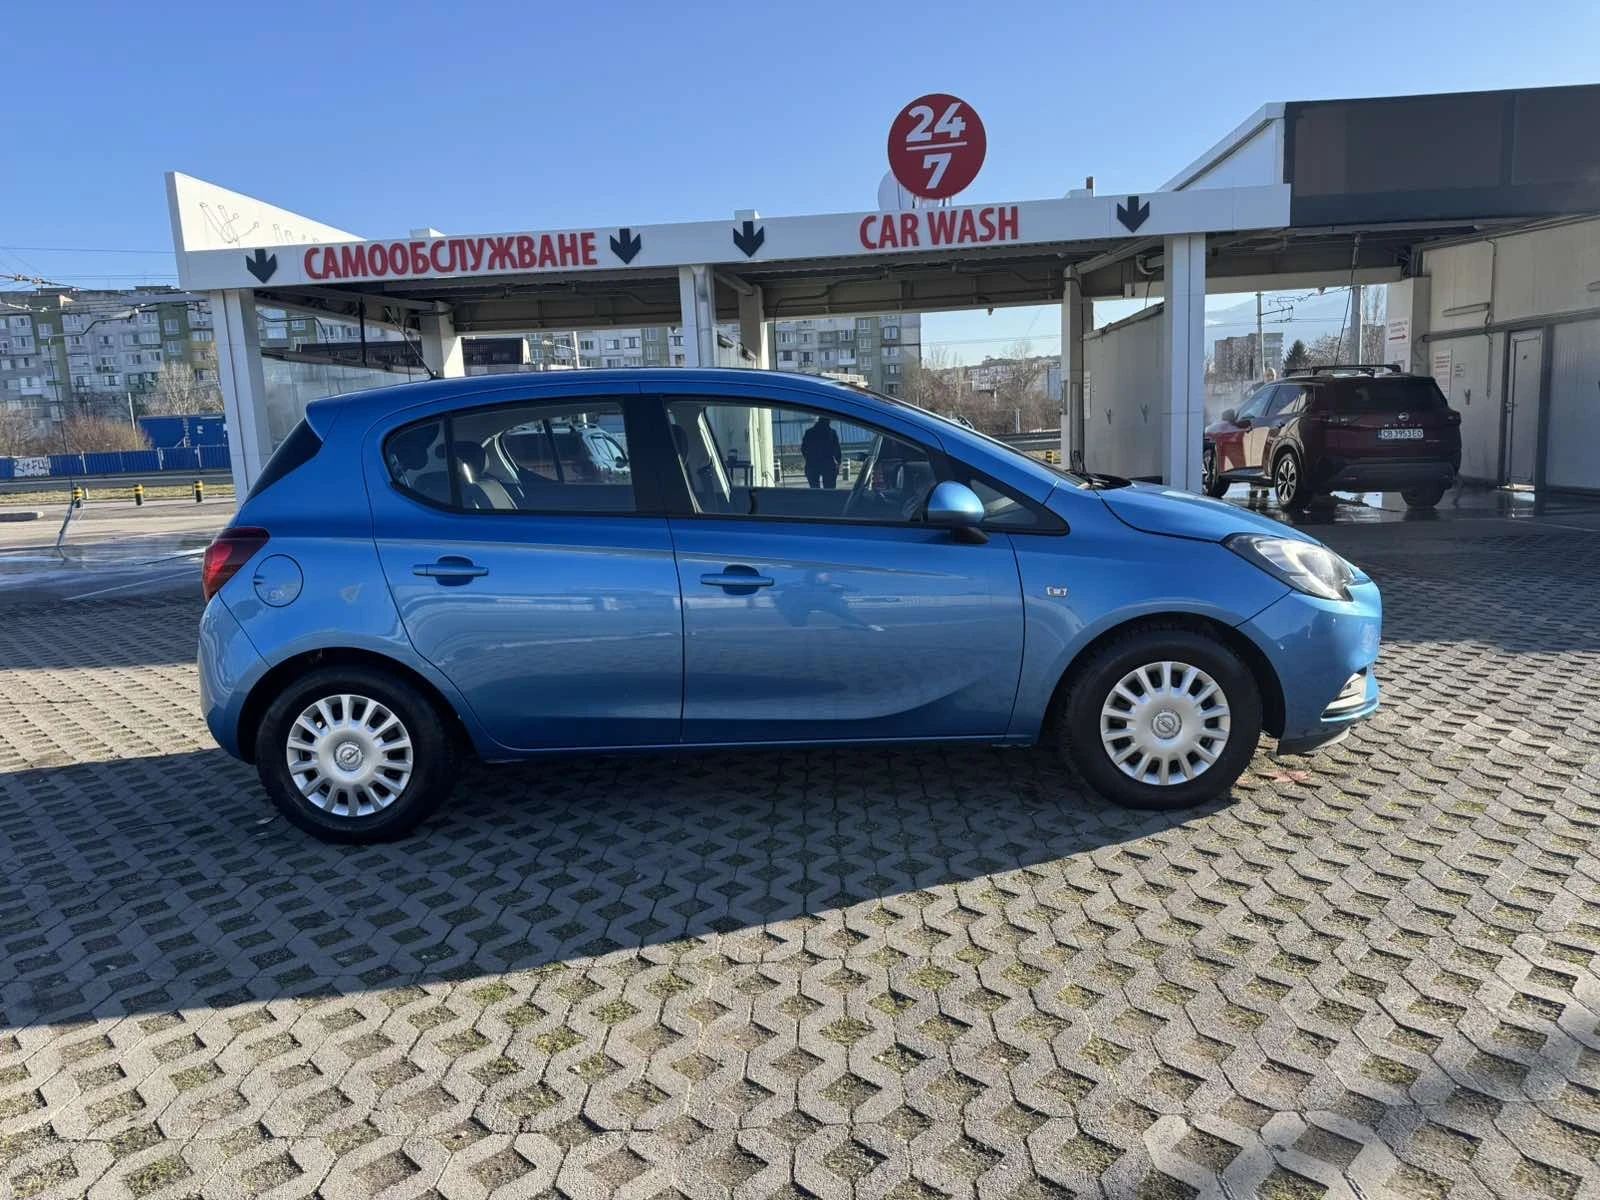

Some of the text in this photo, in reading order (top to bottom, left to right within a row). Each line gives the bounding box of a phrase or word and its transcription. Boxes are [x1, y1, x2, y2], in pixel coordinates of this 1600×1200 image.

[906, 102, 967, 143] 24
[923, 152, 952, 190] 7
[859, 205, 1019, 250] CAR WASH
[304, 231, 598, 280] САМООБСЛУЖВАНЕ
